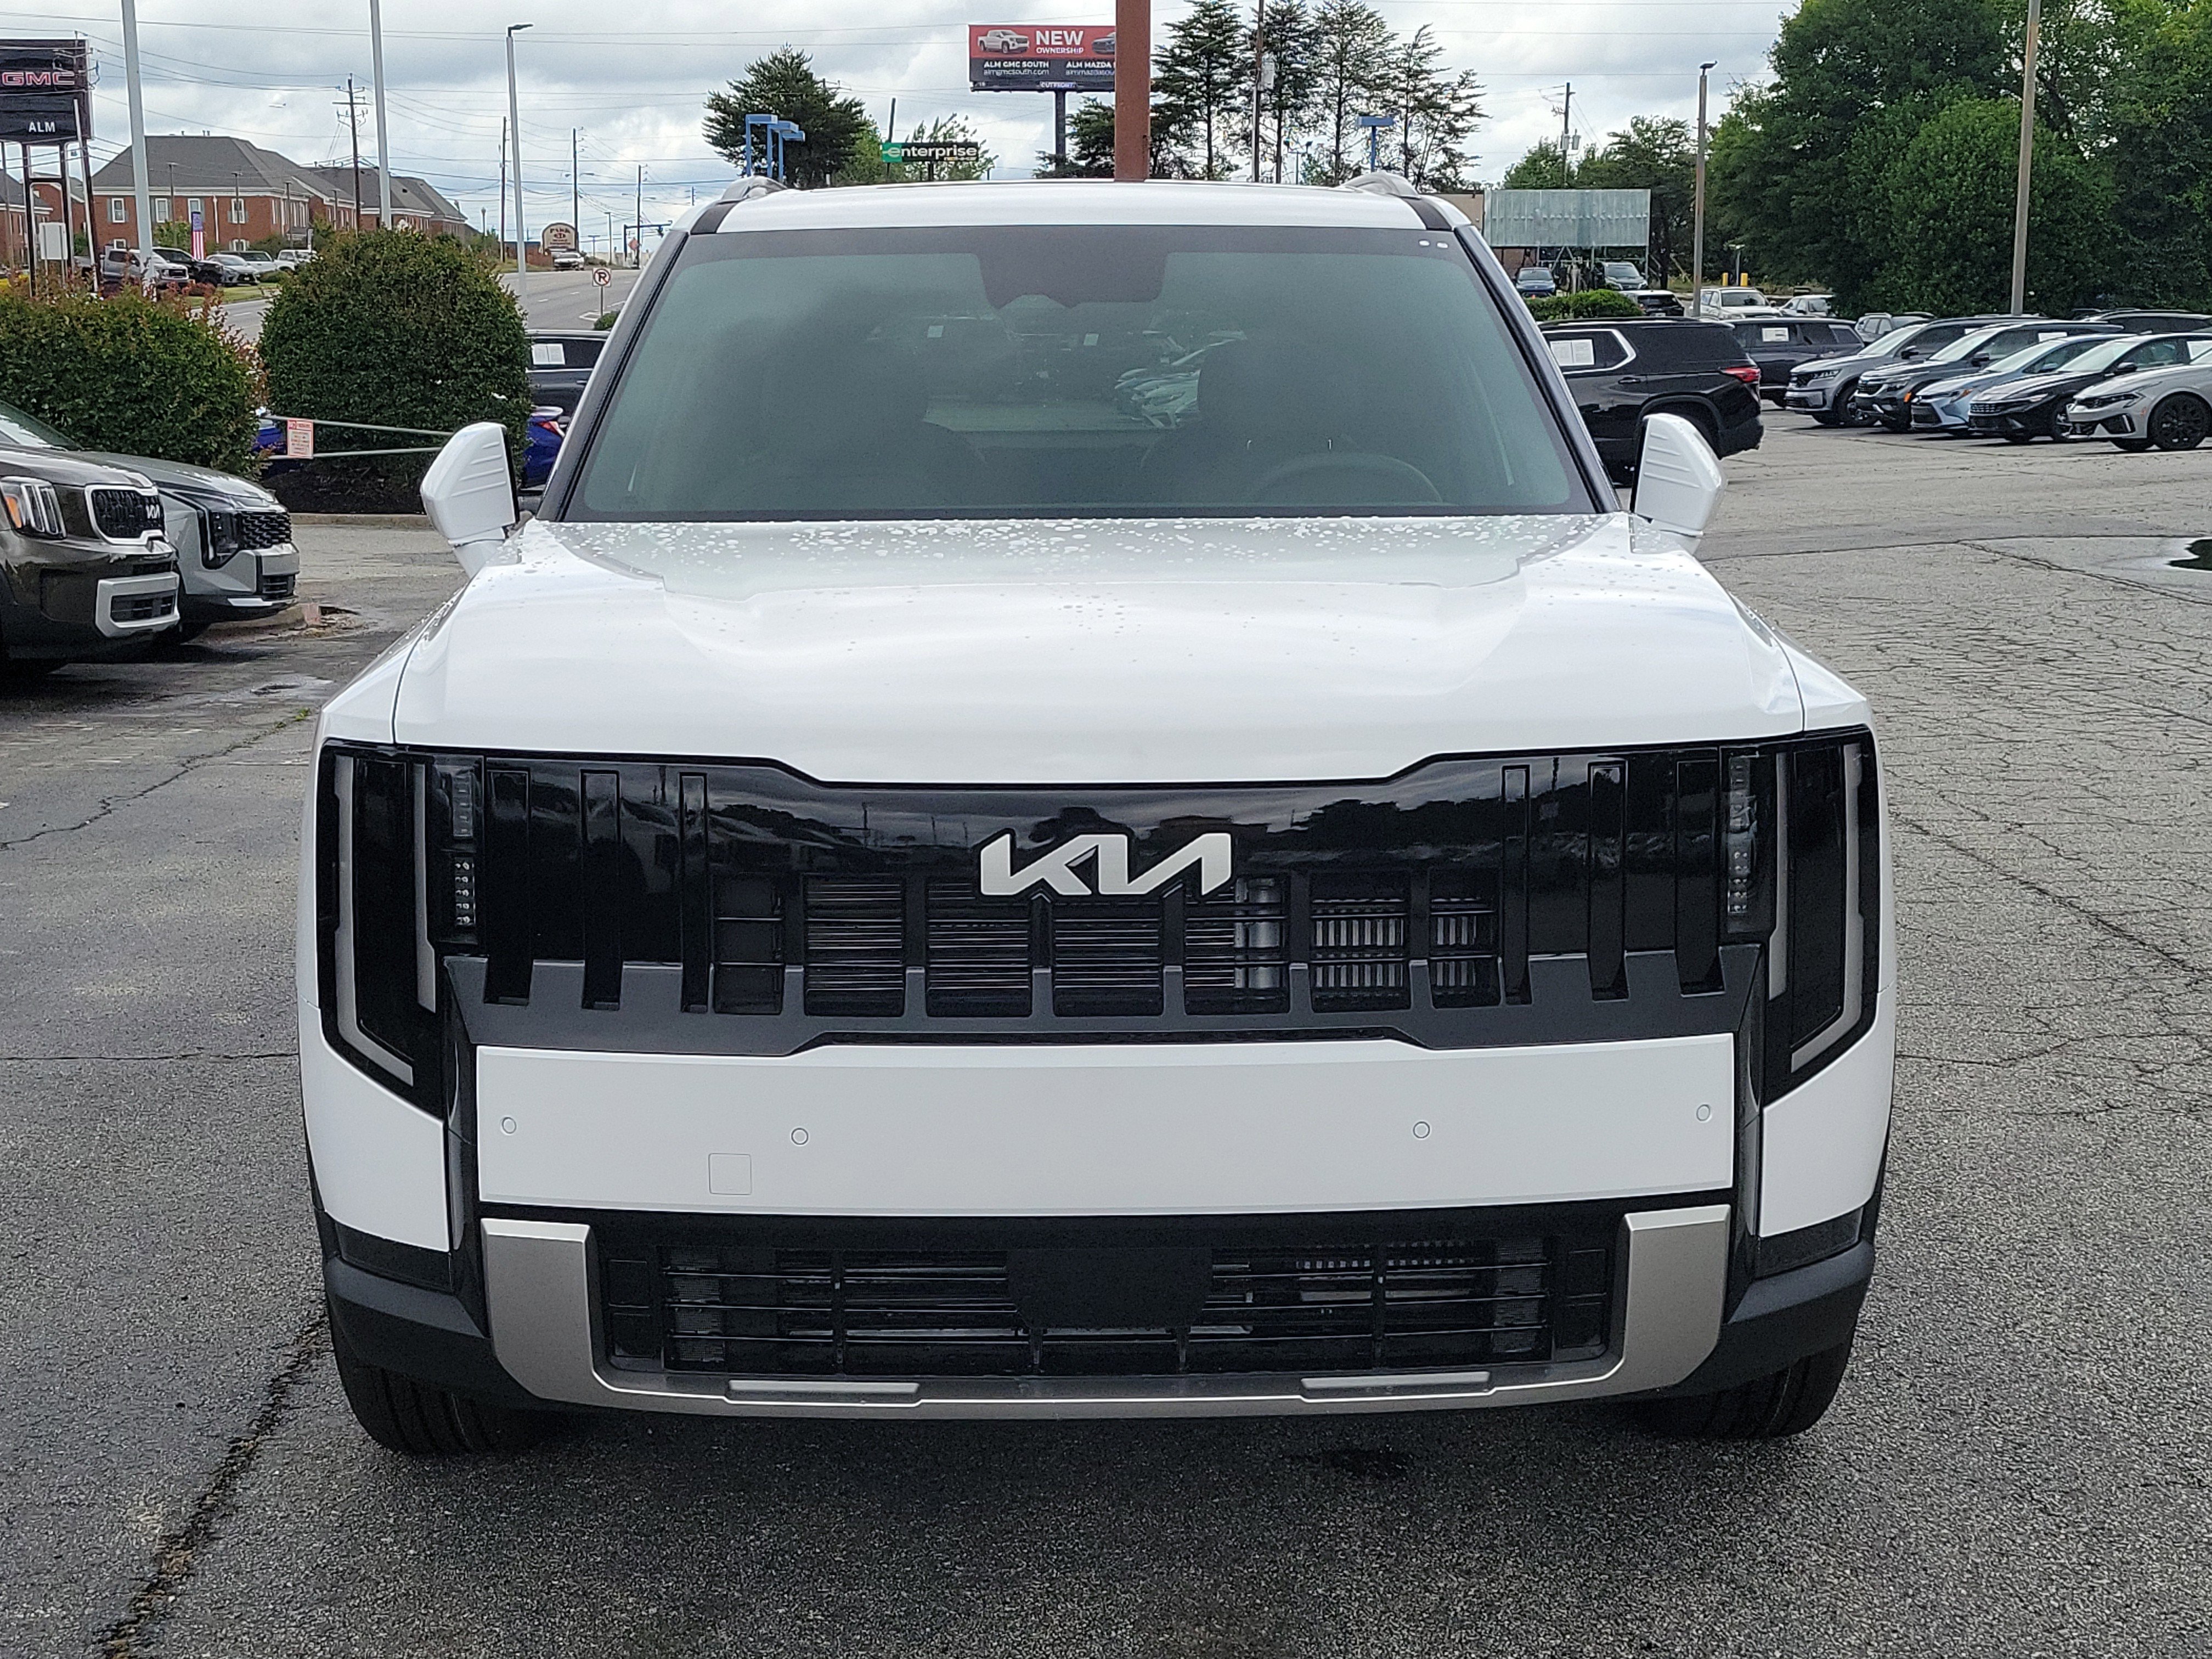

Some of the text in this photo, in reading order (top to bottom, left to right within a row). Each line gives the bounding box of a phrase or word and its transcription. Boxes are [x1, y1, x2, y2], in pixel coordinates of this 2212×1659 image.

[1036, 30, 1084, 45] NEW
[2, 72, 75, 85] GMC
[29, 122, 55, 132] ALM
[887, 145, 977, 160] enterprise
[980, 833, 1232, 896] KIA
